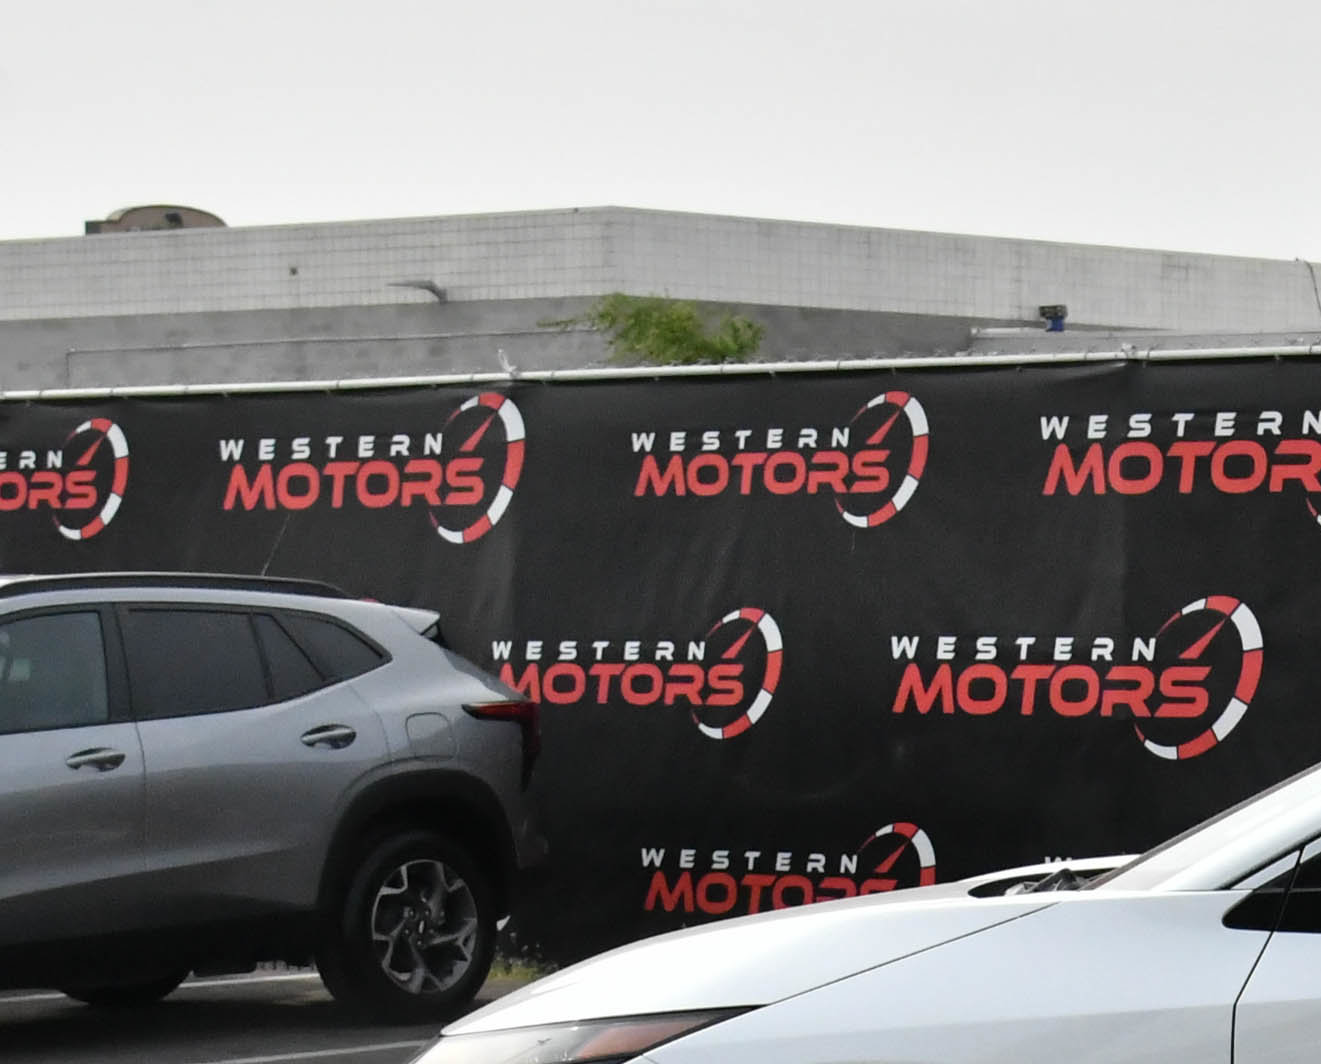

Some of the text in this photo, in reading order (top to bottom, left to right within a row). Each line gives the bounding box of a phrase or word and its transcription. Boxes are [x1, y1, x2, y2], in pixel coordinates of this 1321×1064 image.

[219, 432, 443, 461] WESTERN
[631, 427, 850, 452] WESTERN
[223, 457, 485, 510] MOTORS
[633, 449, 891, 496] MOTORS
[0, 470, 98, 510] ORS
[491, 640, 706, 660] WESTERN
[890, 634, 1157, 660] WESTERN
[500, 662, 744, 706] MOTORS
[892, 662, 1212, 718] MOTORS
[640, 847, 858, 874] WESTERN
